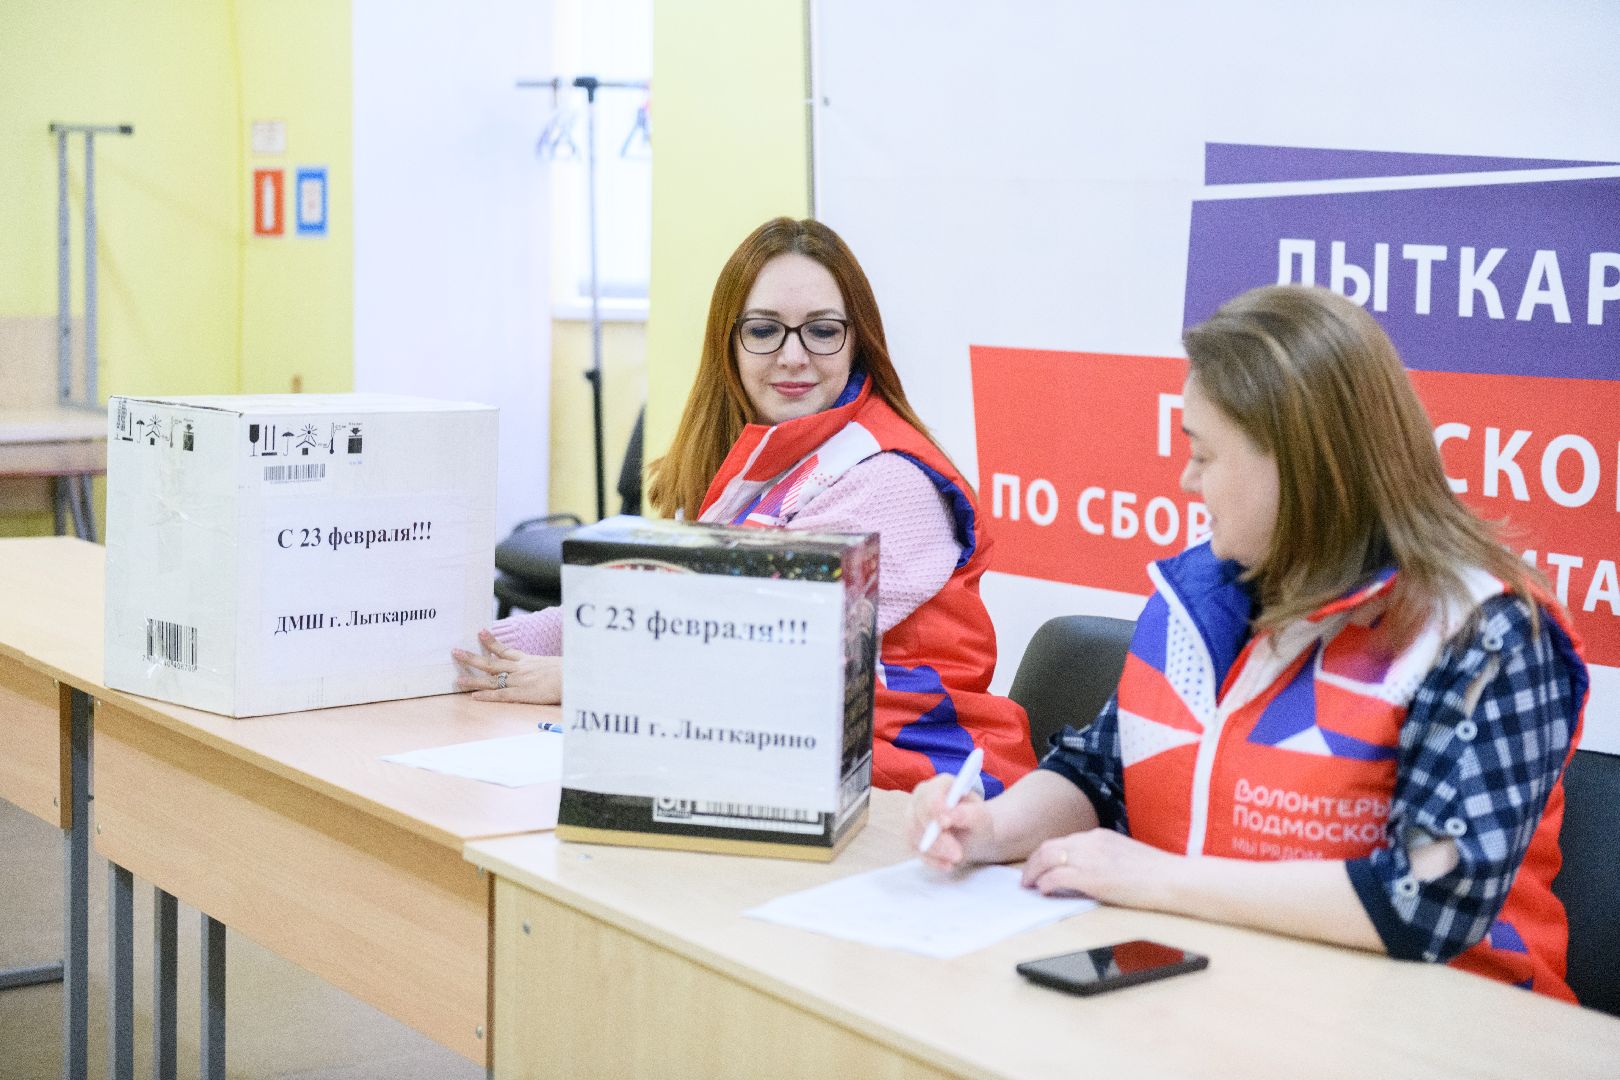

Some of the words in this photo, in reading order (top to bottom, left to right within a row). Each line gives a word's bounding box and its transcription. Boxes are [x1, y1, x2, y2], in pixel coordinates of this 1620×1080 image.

[992, 473, 1058, 526] ПО
[277, 528, 294, 549] С
[300, 527, 321, 548] 23
[328, 521, 432, 551] февраля!!!
[274, 613, 325, 636] ДМШ
[329, 618, 341, 628] г.
[345, 607, 437, 626] Лыткарино
[575, 603, 596, 628] С
[605, 606, 636, 632] 23
[647, 610, 808, 645] февраля!!!
[571, 709, 640, 735] ДМШ
[648, 721, 666, 738] г.
[673, 719, 817, 751] Лыткарино
